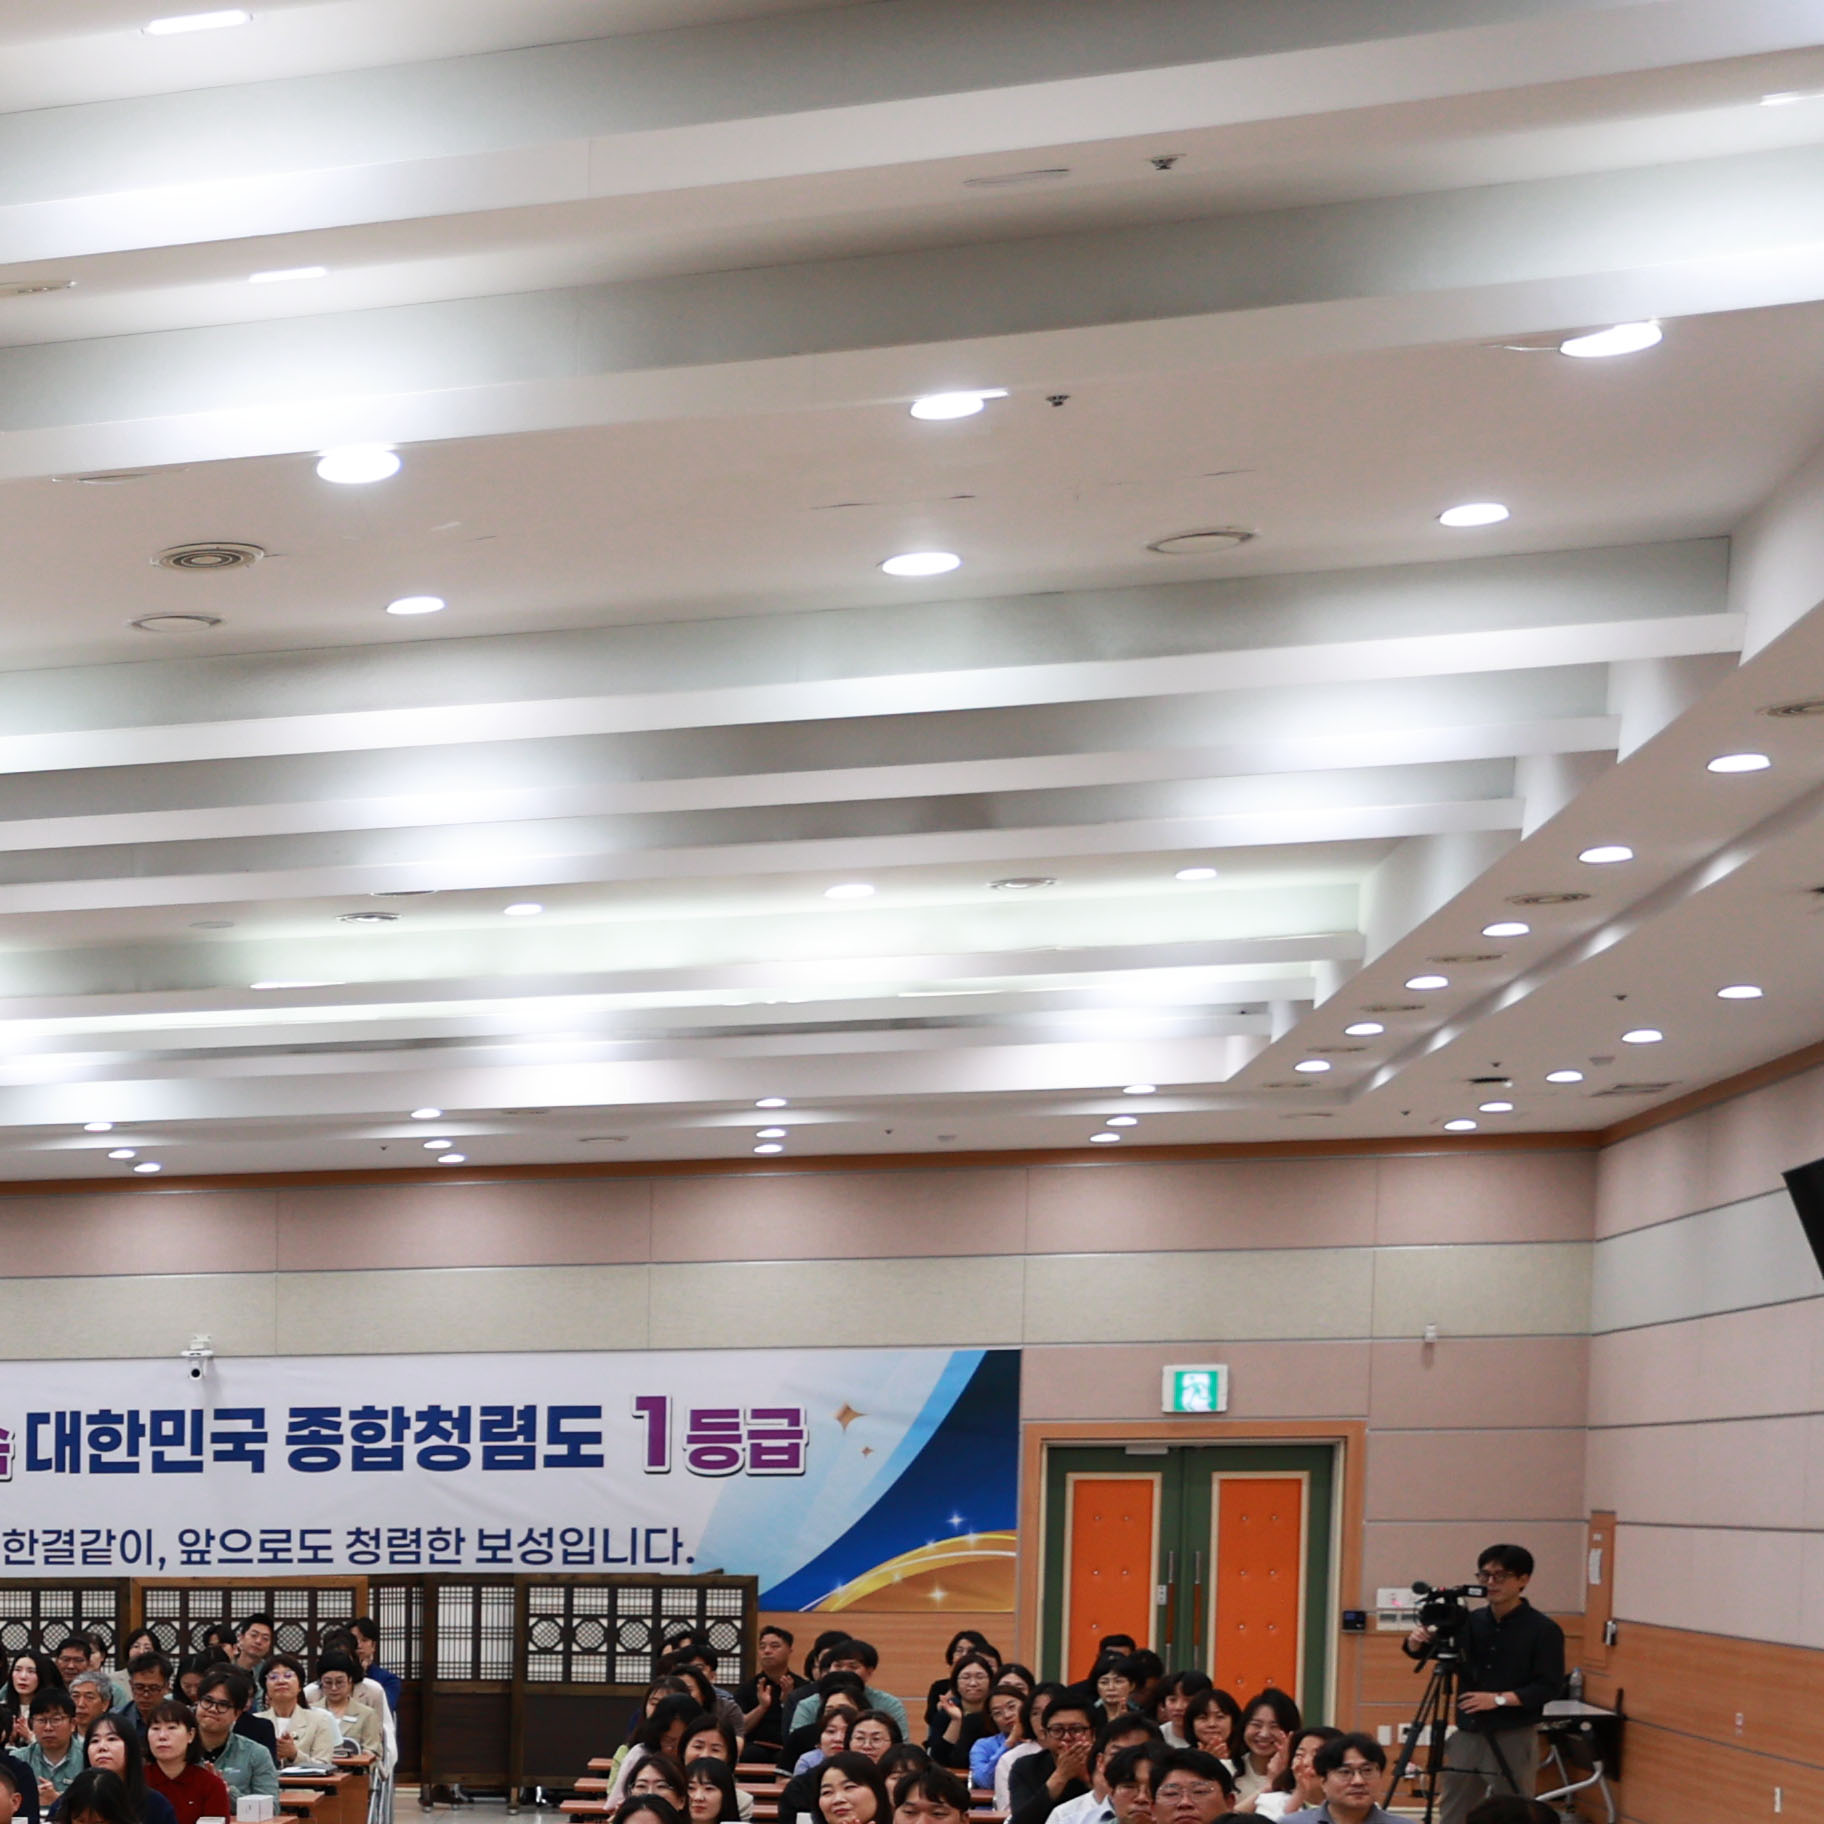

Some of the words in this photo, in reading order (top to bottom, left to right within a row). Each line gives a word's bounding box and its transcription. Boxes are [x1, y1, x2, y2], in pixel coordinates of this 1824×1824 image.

[26, 1407, 269, 1475] 대한민국
[285, 1404, 605, 1473] 종합청렴도
[630, 1394, 809, 1478] 1등급
[2, 1528, 167, 1572] 한결같이,
[177, 1528, 334, 1566] 앞으로도
[345, 1526, 467, 1566] 청렴한
[475, 1526, 696, 1566] 보성입니다.
